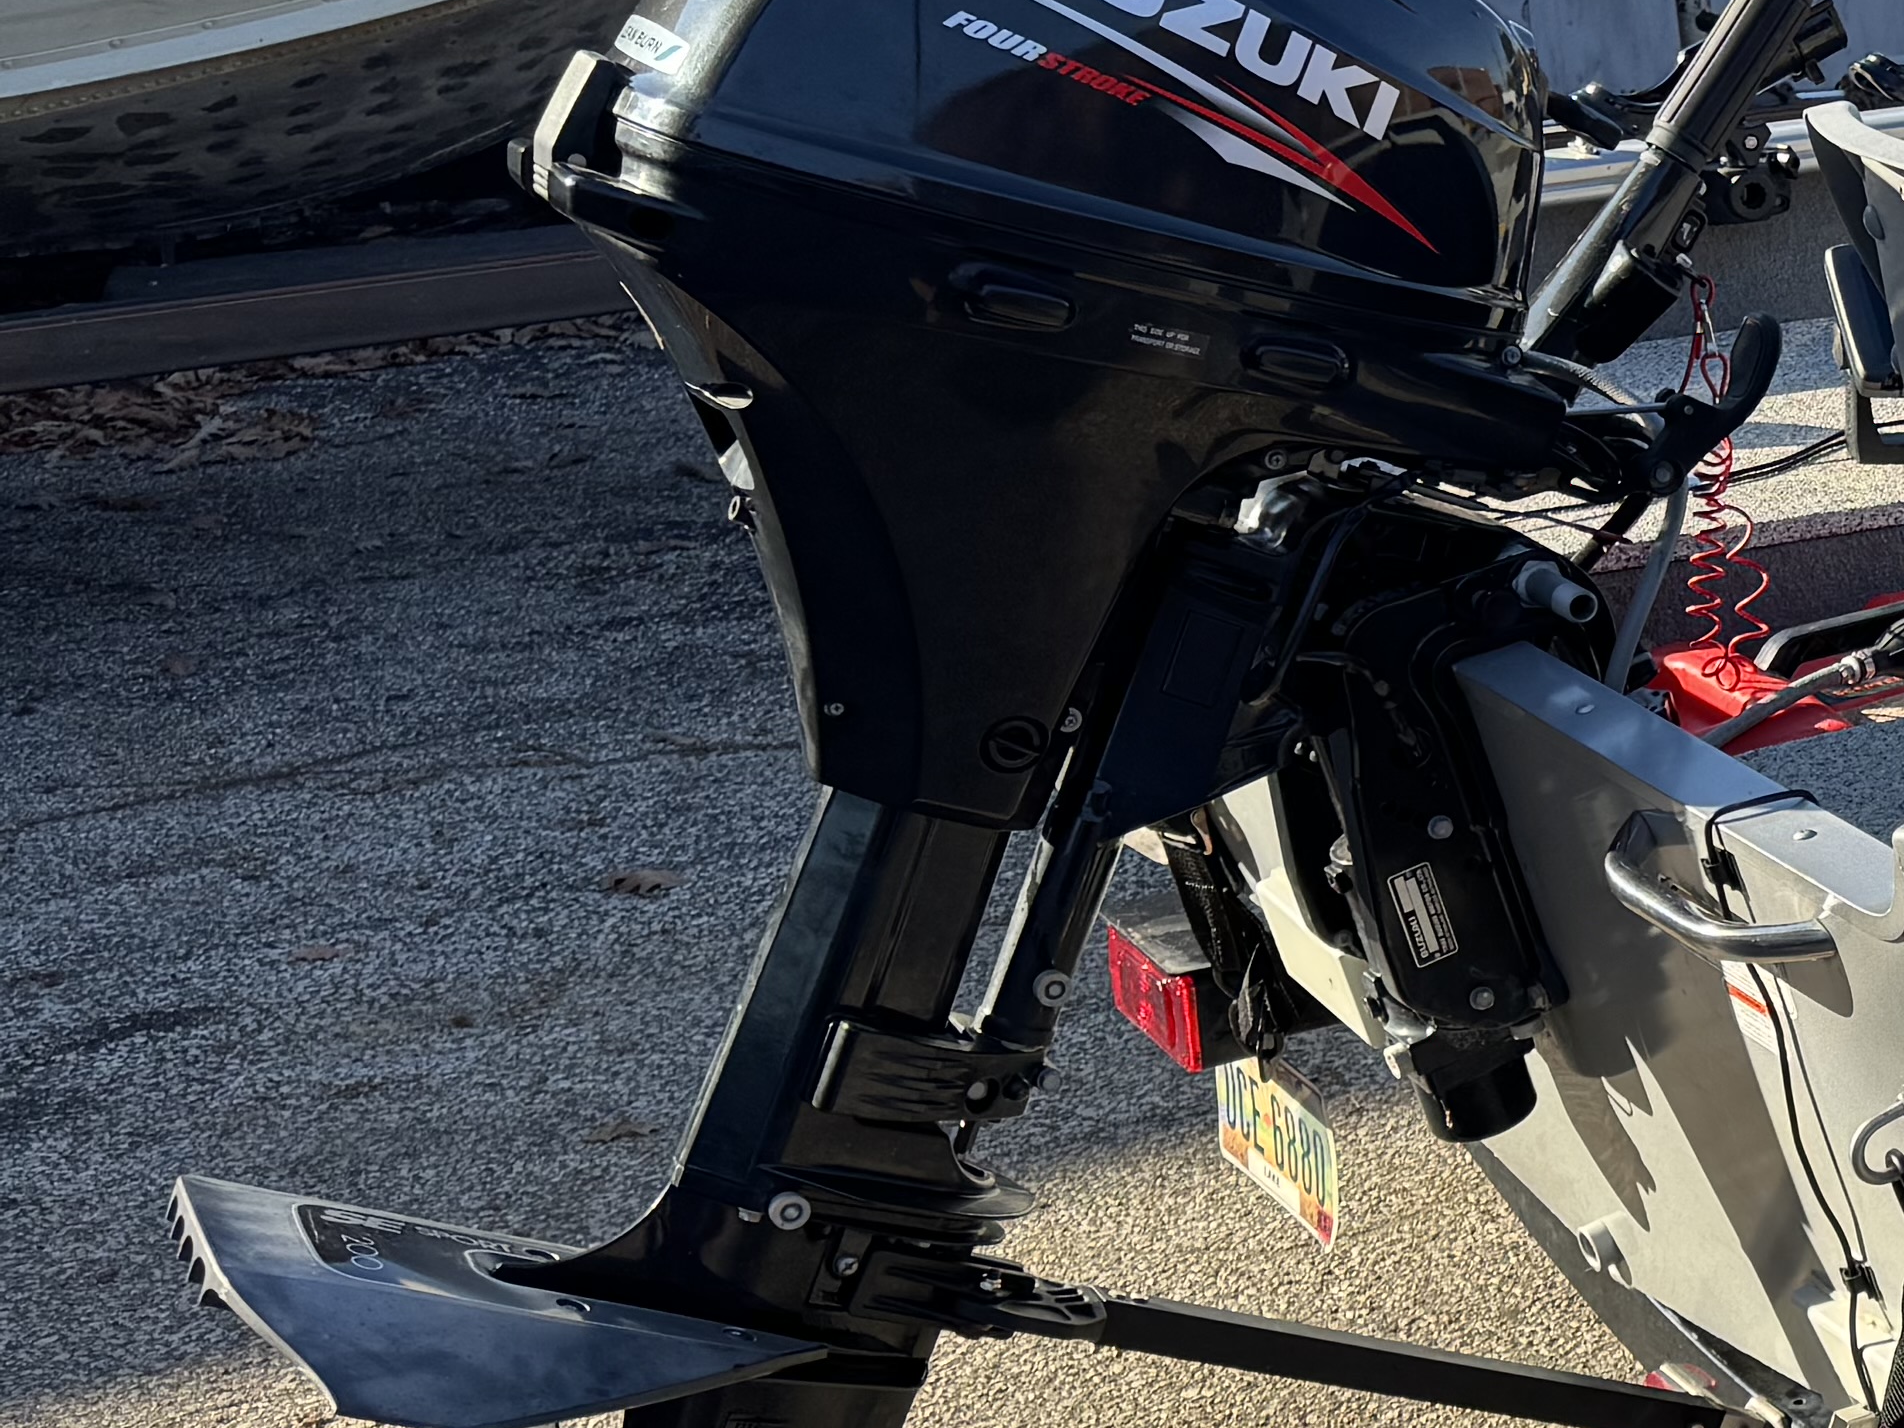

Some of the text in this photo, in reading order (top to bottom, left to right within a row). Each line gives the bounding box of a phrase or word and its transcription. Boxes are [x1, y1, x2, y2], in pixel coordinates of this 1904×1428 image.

[1270, 1093, 1326, 1209] 6880
[341, 1233, 384, 1271] 200
[414, 1225, 514, 1254] SPORT
